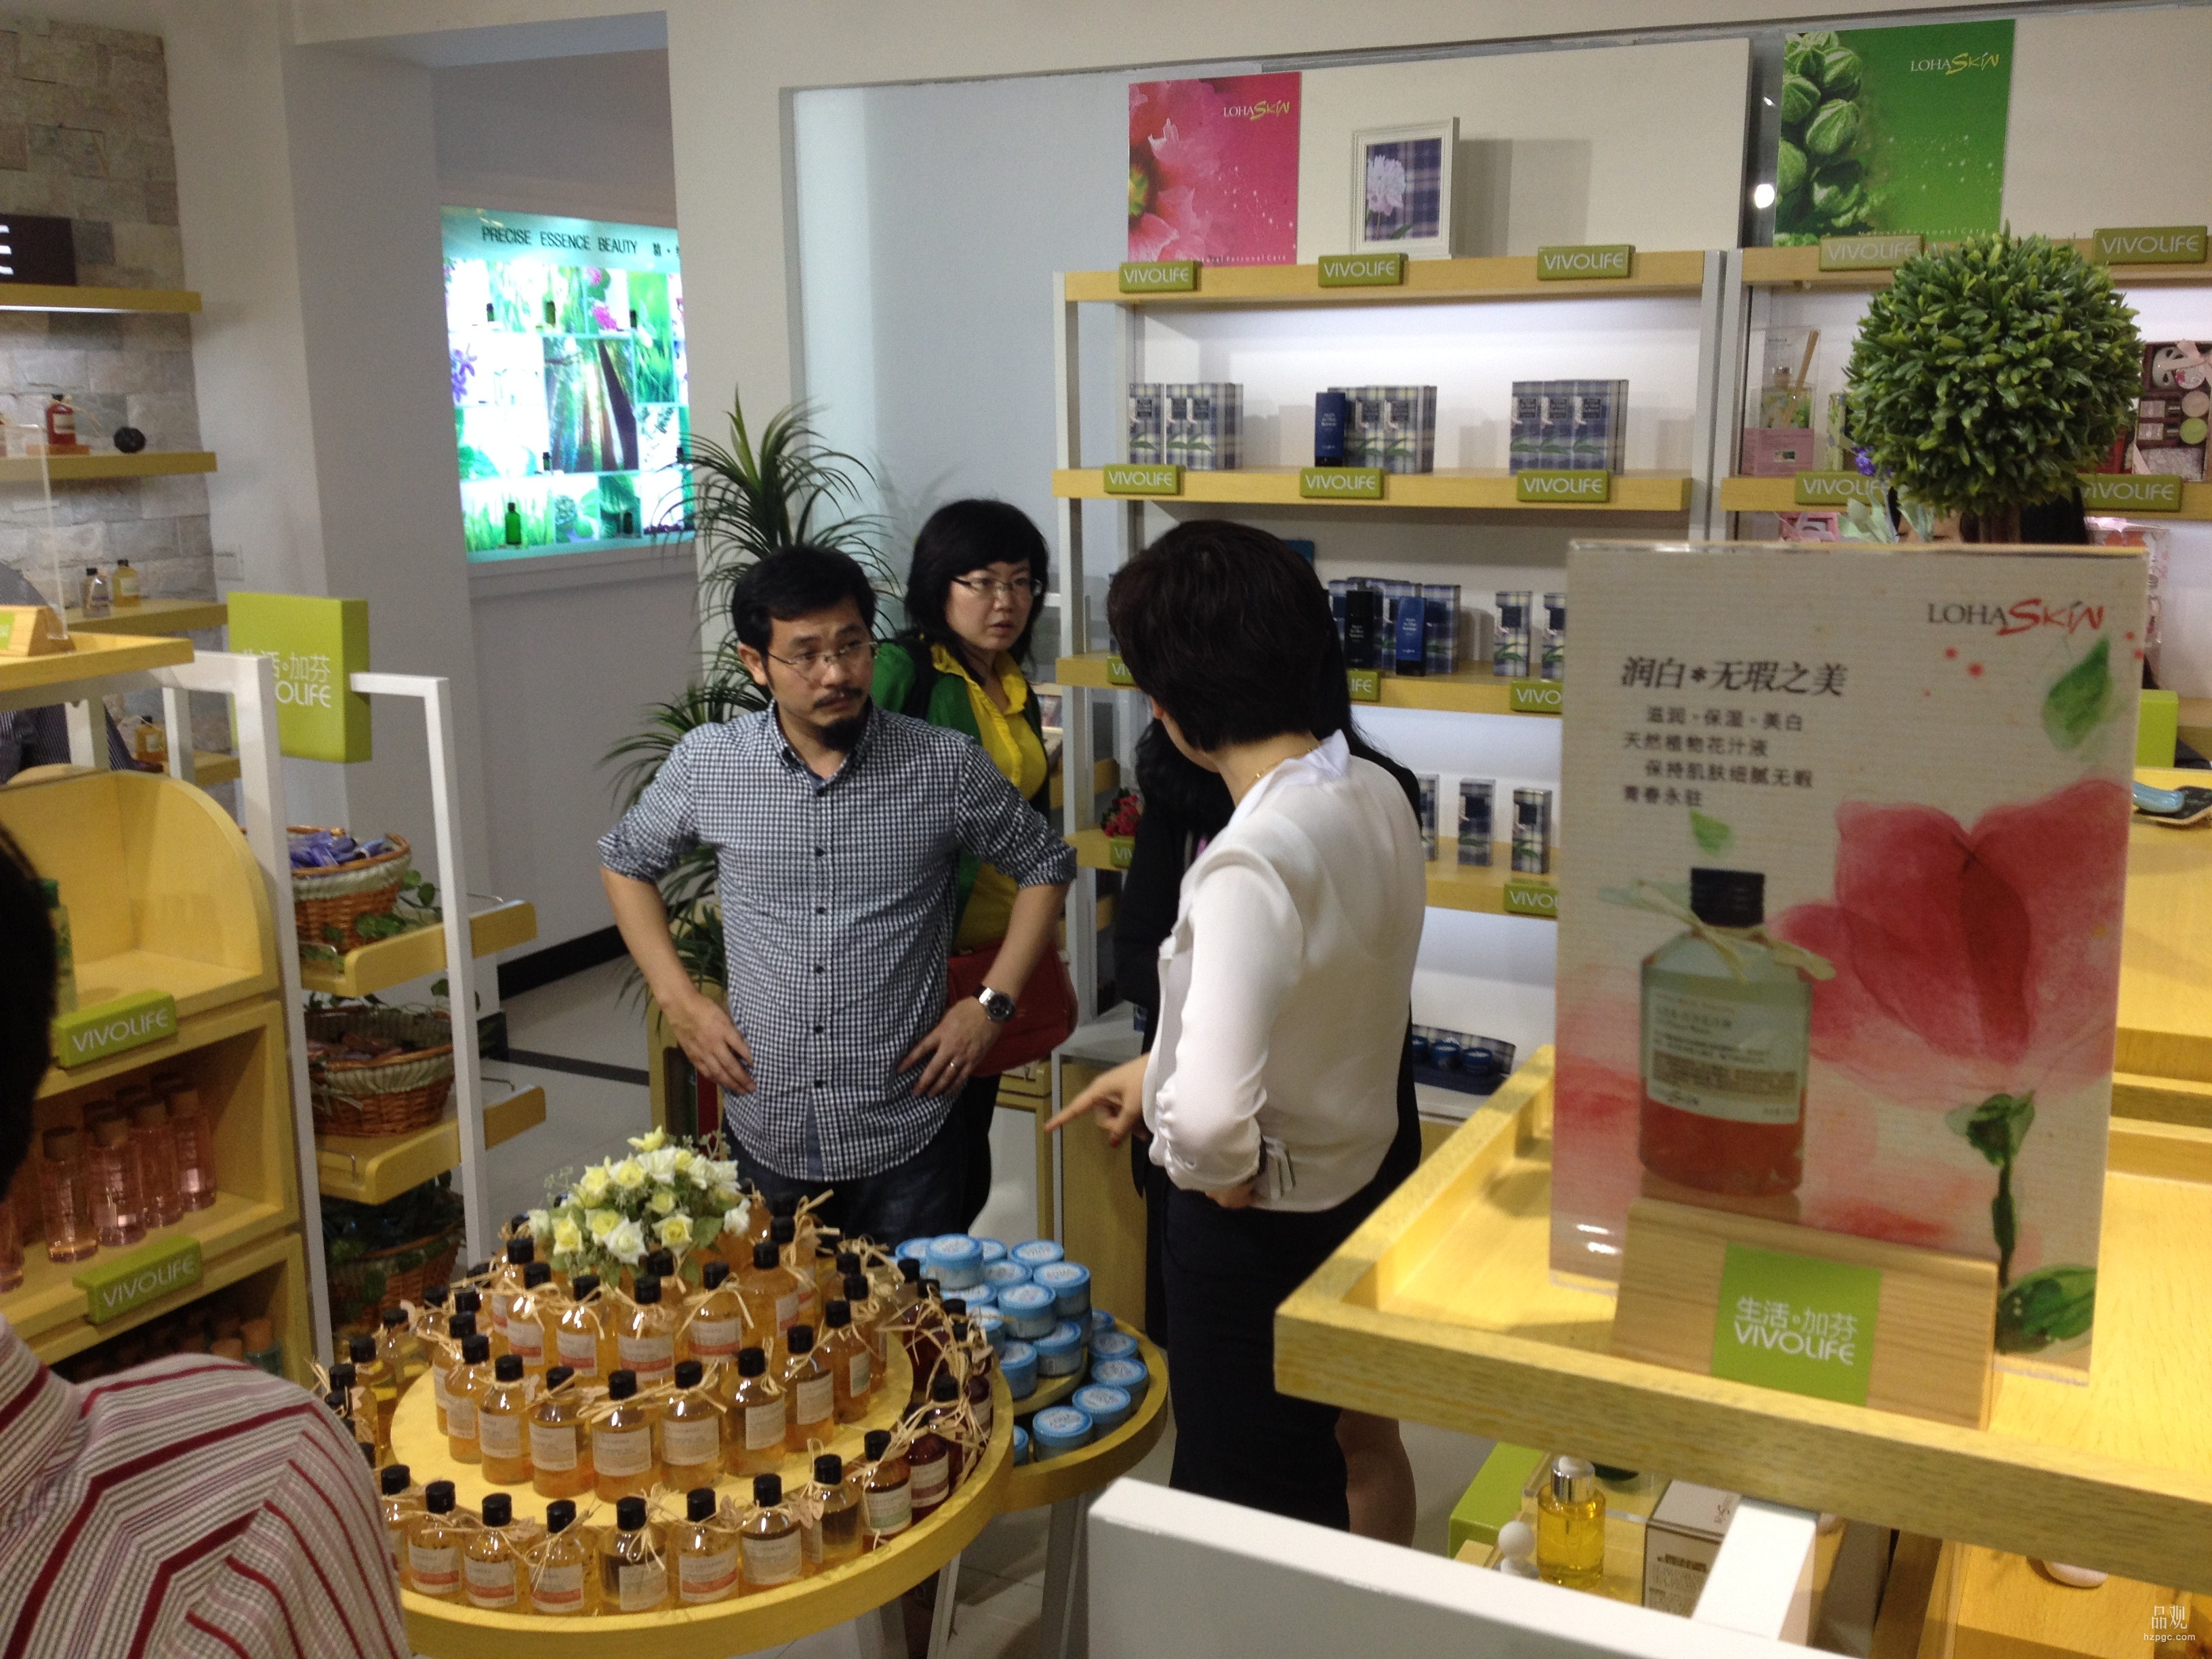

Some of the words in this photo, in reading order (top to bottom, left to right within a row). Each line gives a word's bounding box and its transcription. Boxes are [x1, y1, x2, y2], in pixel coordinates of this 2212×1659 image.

[481, 226, 532, 245] PRECISE
[539, 231, 591, 251] ESSENCE
[598, 237, 638, 254] BEAUTY
[1906, 226, 1958, 236] Personal
[1829, 241, 1916, 261] VIVOLIFE
[2101, 234, 2199, 255] VIVOLIFE
[1226, 254, 1265, 262] Personal
[1267, 253, 1287, 262] Care
[1543, 252, 1623, 270] VIVOLIFE
[1124, 268, 1189, 284] VIVOLIFE
[1324, 261, 1395, 278] VIVOLIFE
[1108, 470, 1172, 487] VIVOLIFE
[1305, 474, 1376, 490] VIVOLIFE
[1523, 477, 1603, 494] VIVOLIFE
[275, 680, 331, 708] OLIFE
[72, 1008, 168, 1052] VIVOLIFE
[103, 1254, 194, 1308] VIVOLIFE
[1734, 1320, 1856, 1366] VIVOLIFE
